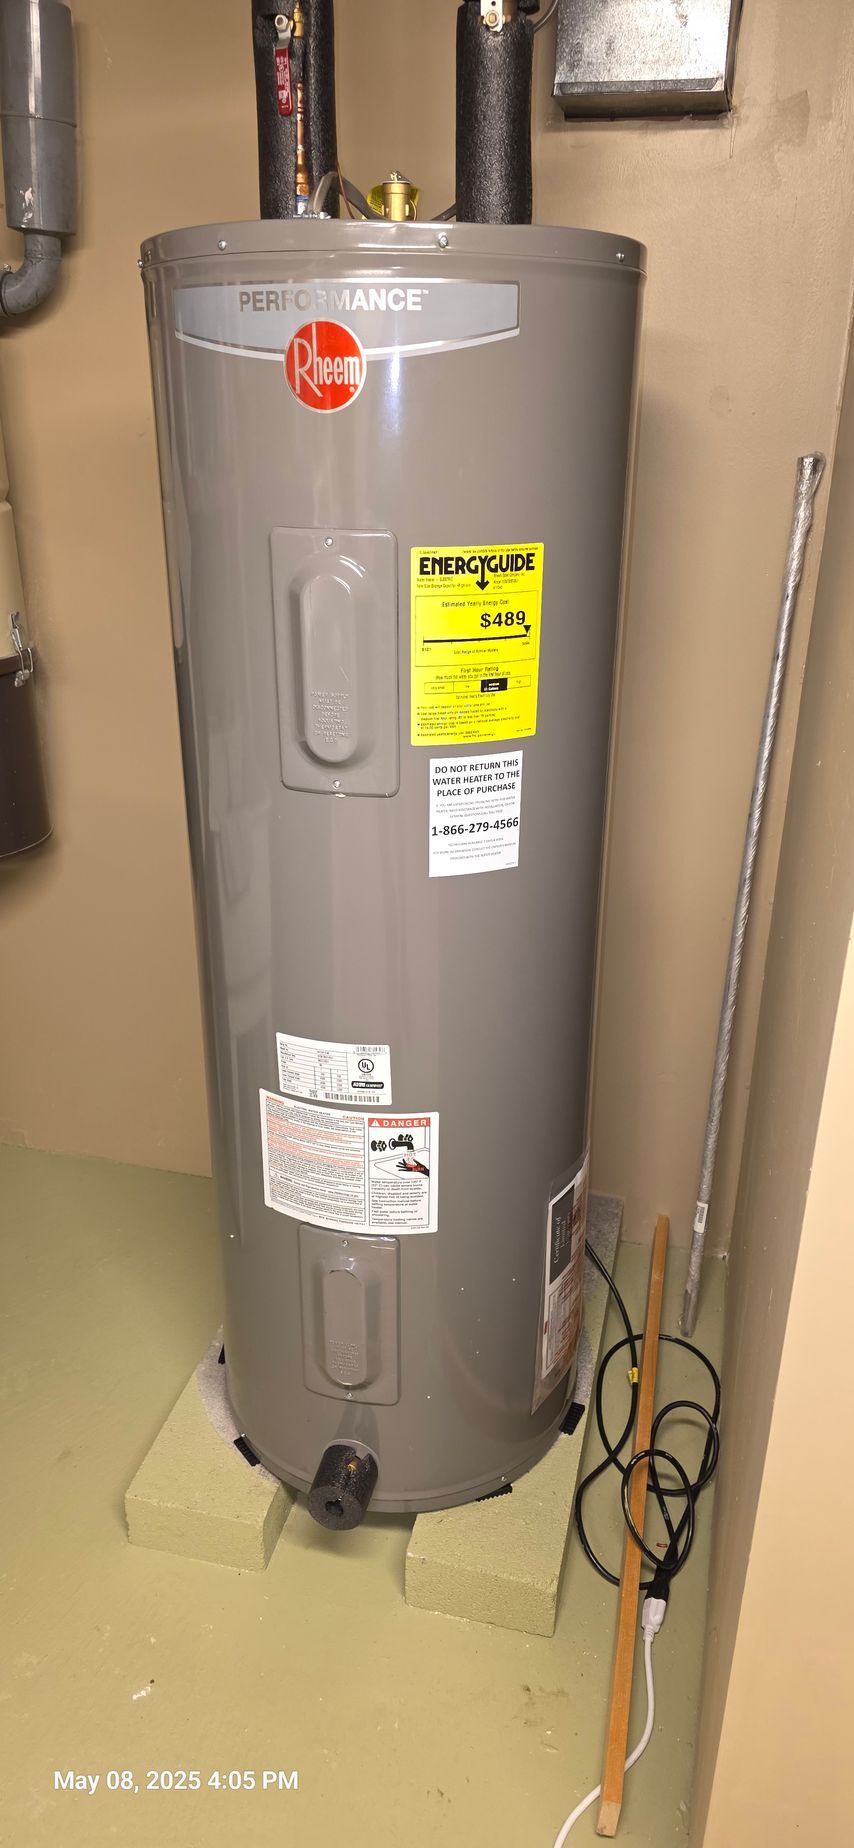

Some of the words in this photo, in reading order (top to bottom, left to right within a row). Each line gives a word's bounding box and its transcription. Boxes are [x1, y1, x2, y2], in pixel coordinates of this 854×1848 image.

[419, 553, 536, 576] ENERGYGUIDE
[480, 610, 526, 629] $489
[469, 761, 501, 772] RETURN
[502, 759, 519, 767] THIS
[432, 777, 461, 786] WATER
[463, 774, 492, 783] HEATER
[507, 770, 520, 778] THE
[437, 789, 461, 797] PLACE
[476, 782, 516, 794] PURCHASE
[432, 816, 519, 836] 1-866-279-4566
